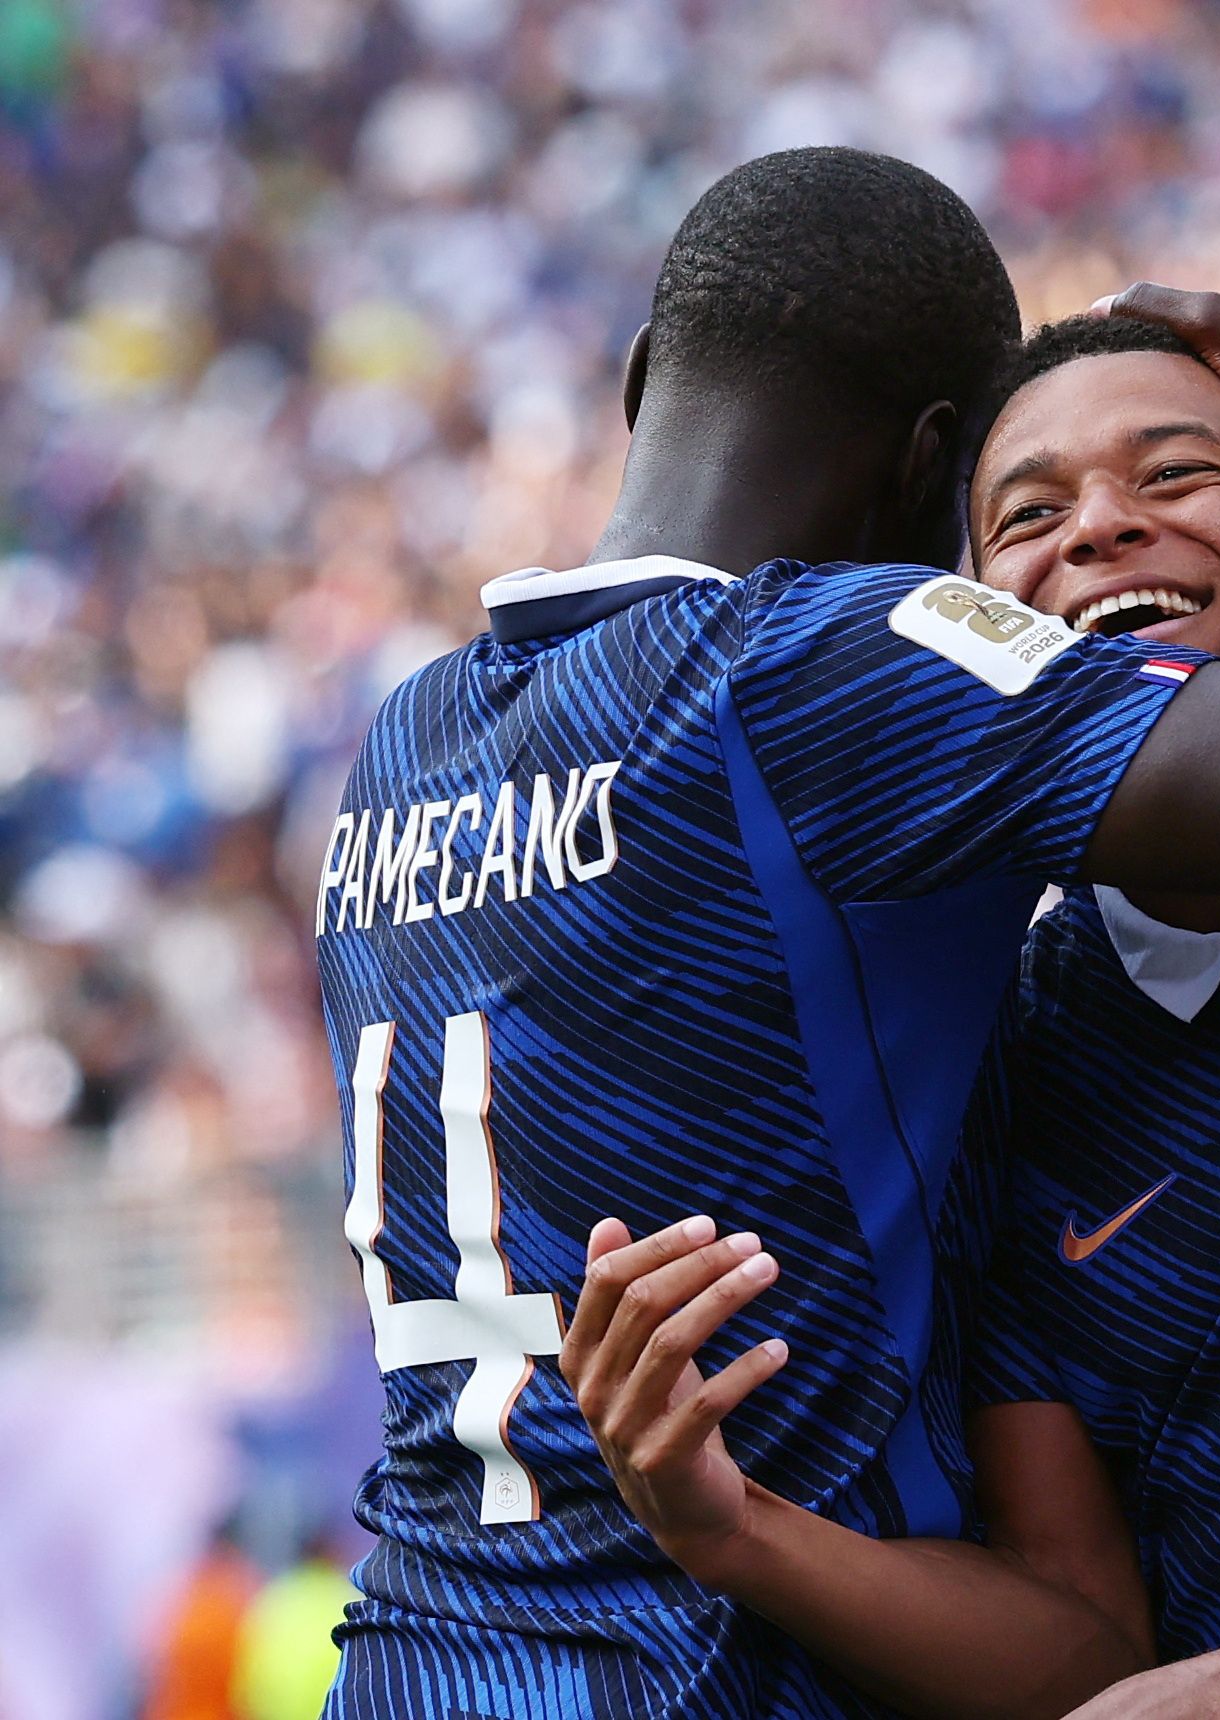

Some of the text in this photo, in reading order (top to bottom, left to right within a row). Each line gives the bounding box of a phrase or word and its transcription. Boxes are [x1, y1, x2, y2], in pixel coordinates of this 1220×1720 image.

[998, 617, 1024, 634] FIFA
[1008, 624, 1050, 654] WORLD CUP
[1019, 631, 1064, 664] 2026
[315, 760, 622, 938] PAMECANO
[344, 1010, 565, 1525] 4
